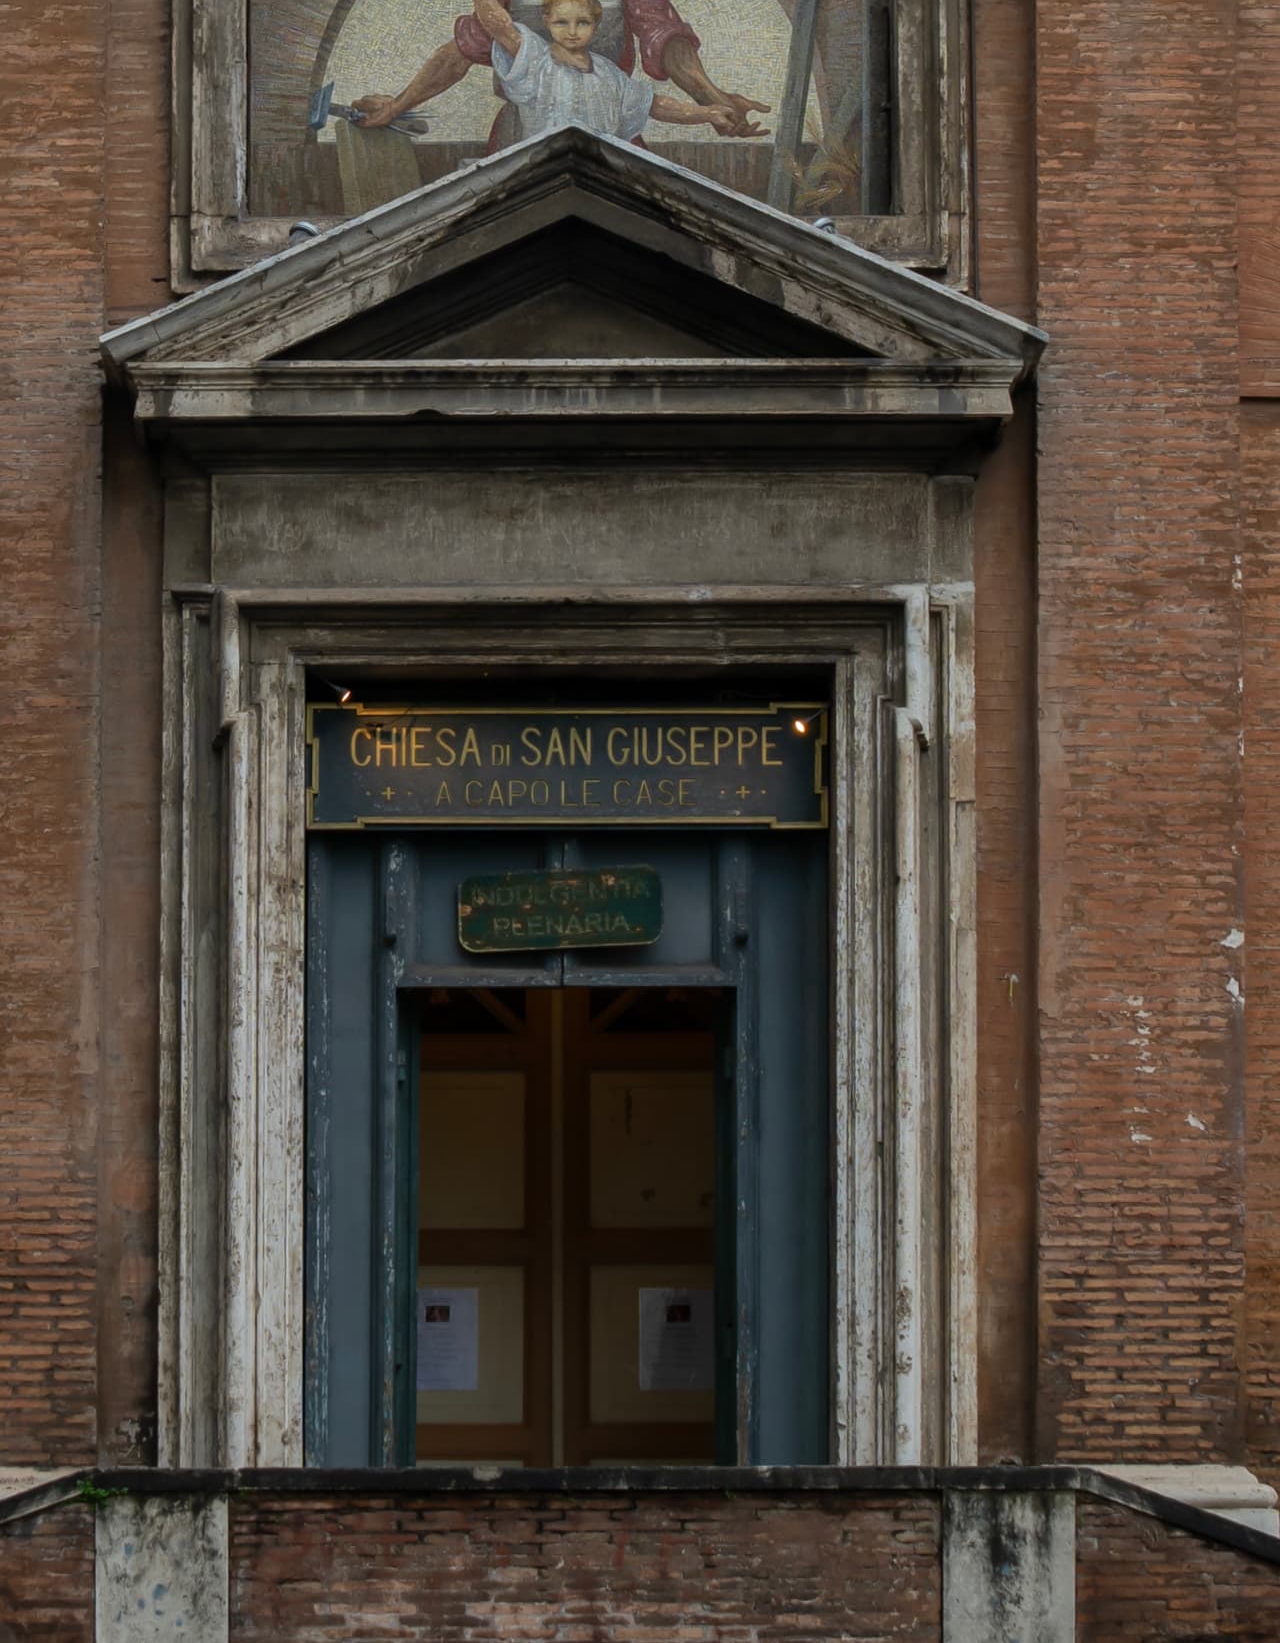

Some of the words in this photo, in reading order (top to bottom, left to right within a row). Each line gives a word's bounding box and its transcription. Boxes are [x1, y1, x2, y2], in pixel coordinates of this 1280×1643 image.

[351, 727, 482, 767] CHIESA
[491, 744, 511, 766] DI
[521, 727, 592, 766] SAN
[607, 727, 783, 766] GIUSEPPE
[435, 780, 452, 807] A
[465, 779, 549, 807] CAPO
[561, 779, 601, 807] LE
[613, 778, 697, 807] CASE
[492, 912, 631, 938] PLENARIA
